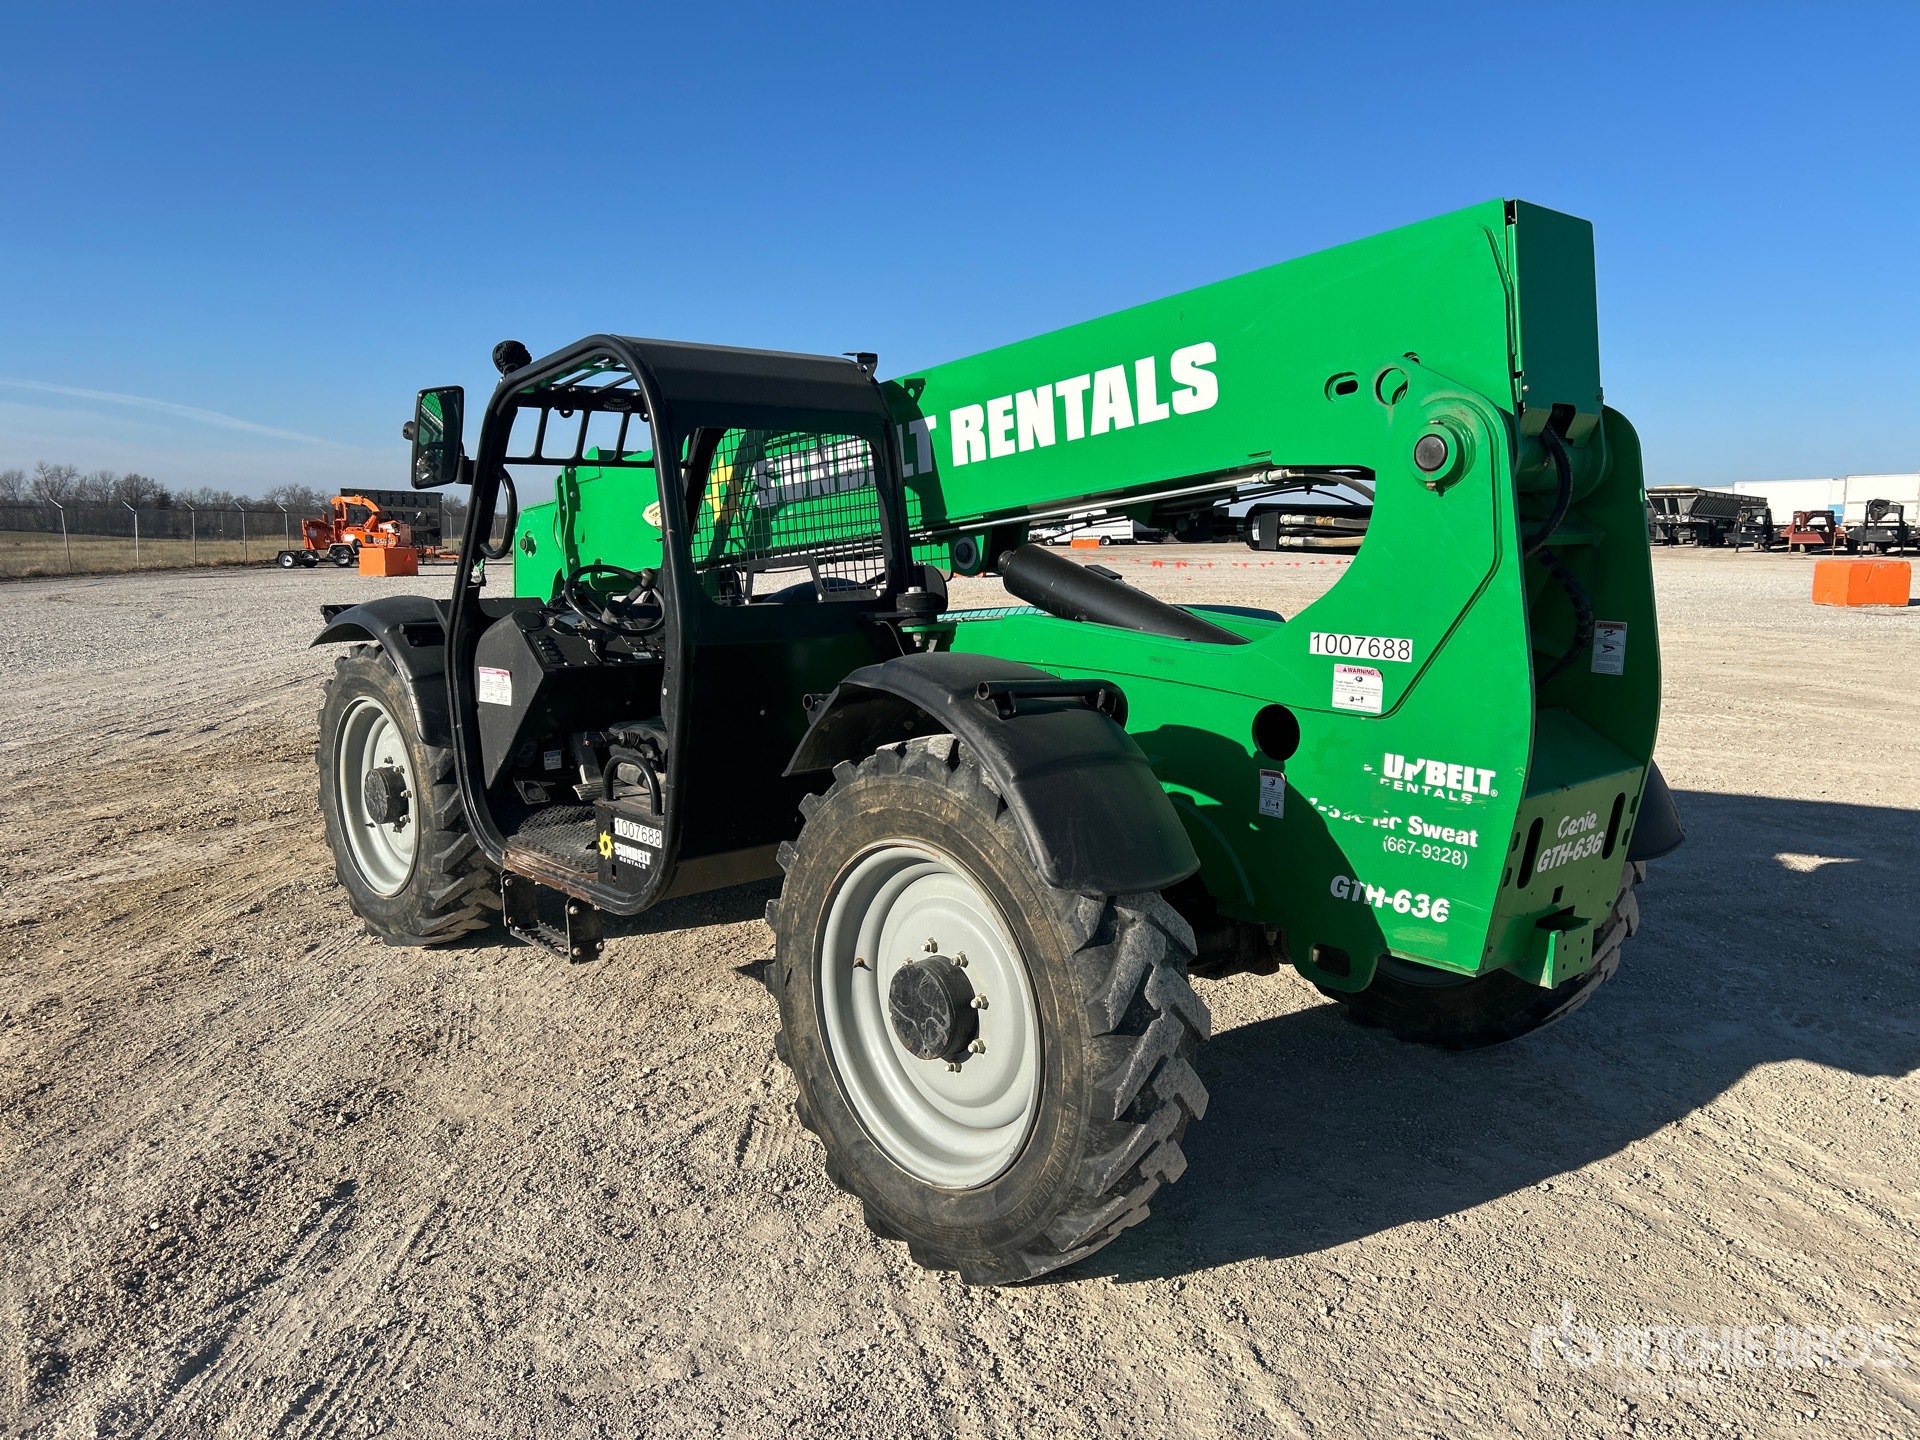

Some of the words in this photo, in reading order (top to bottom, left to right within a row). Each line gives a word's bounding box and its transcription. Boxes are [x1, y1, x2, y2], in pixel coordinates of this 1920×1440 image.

[950, 341, 1218, 467] RENTALS
[1313, 633, 1410, 661] 1007688
[1347, 667, 1375, 676] WARNING
[1363, 752, 1496, 796] UNBELT
[616, 818, 661, 847] 1007688
[1408, 815, 1479, 848] Sweat
[1557, 810, 1598, 839] Genie
[613, 841, 651, 866] SUNBELT
[618, 855, 646, 870] RENTALS
[1383, 834, 1469, 870] (667-9328)
[1536, 831, 1605, 873] GTH-636
[1330, 875, 1451, 923] GTH-636
